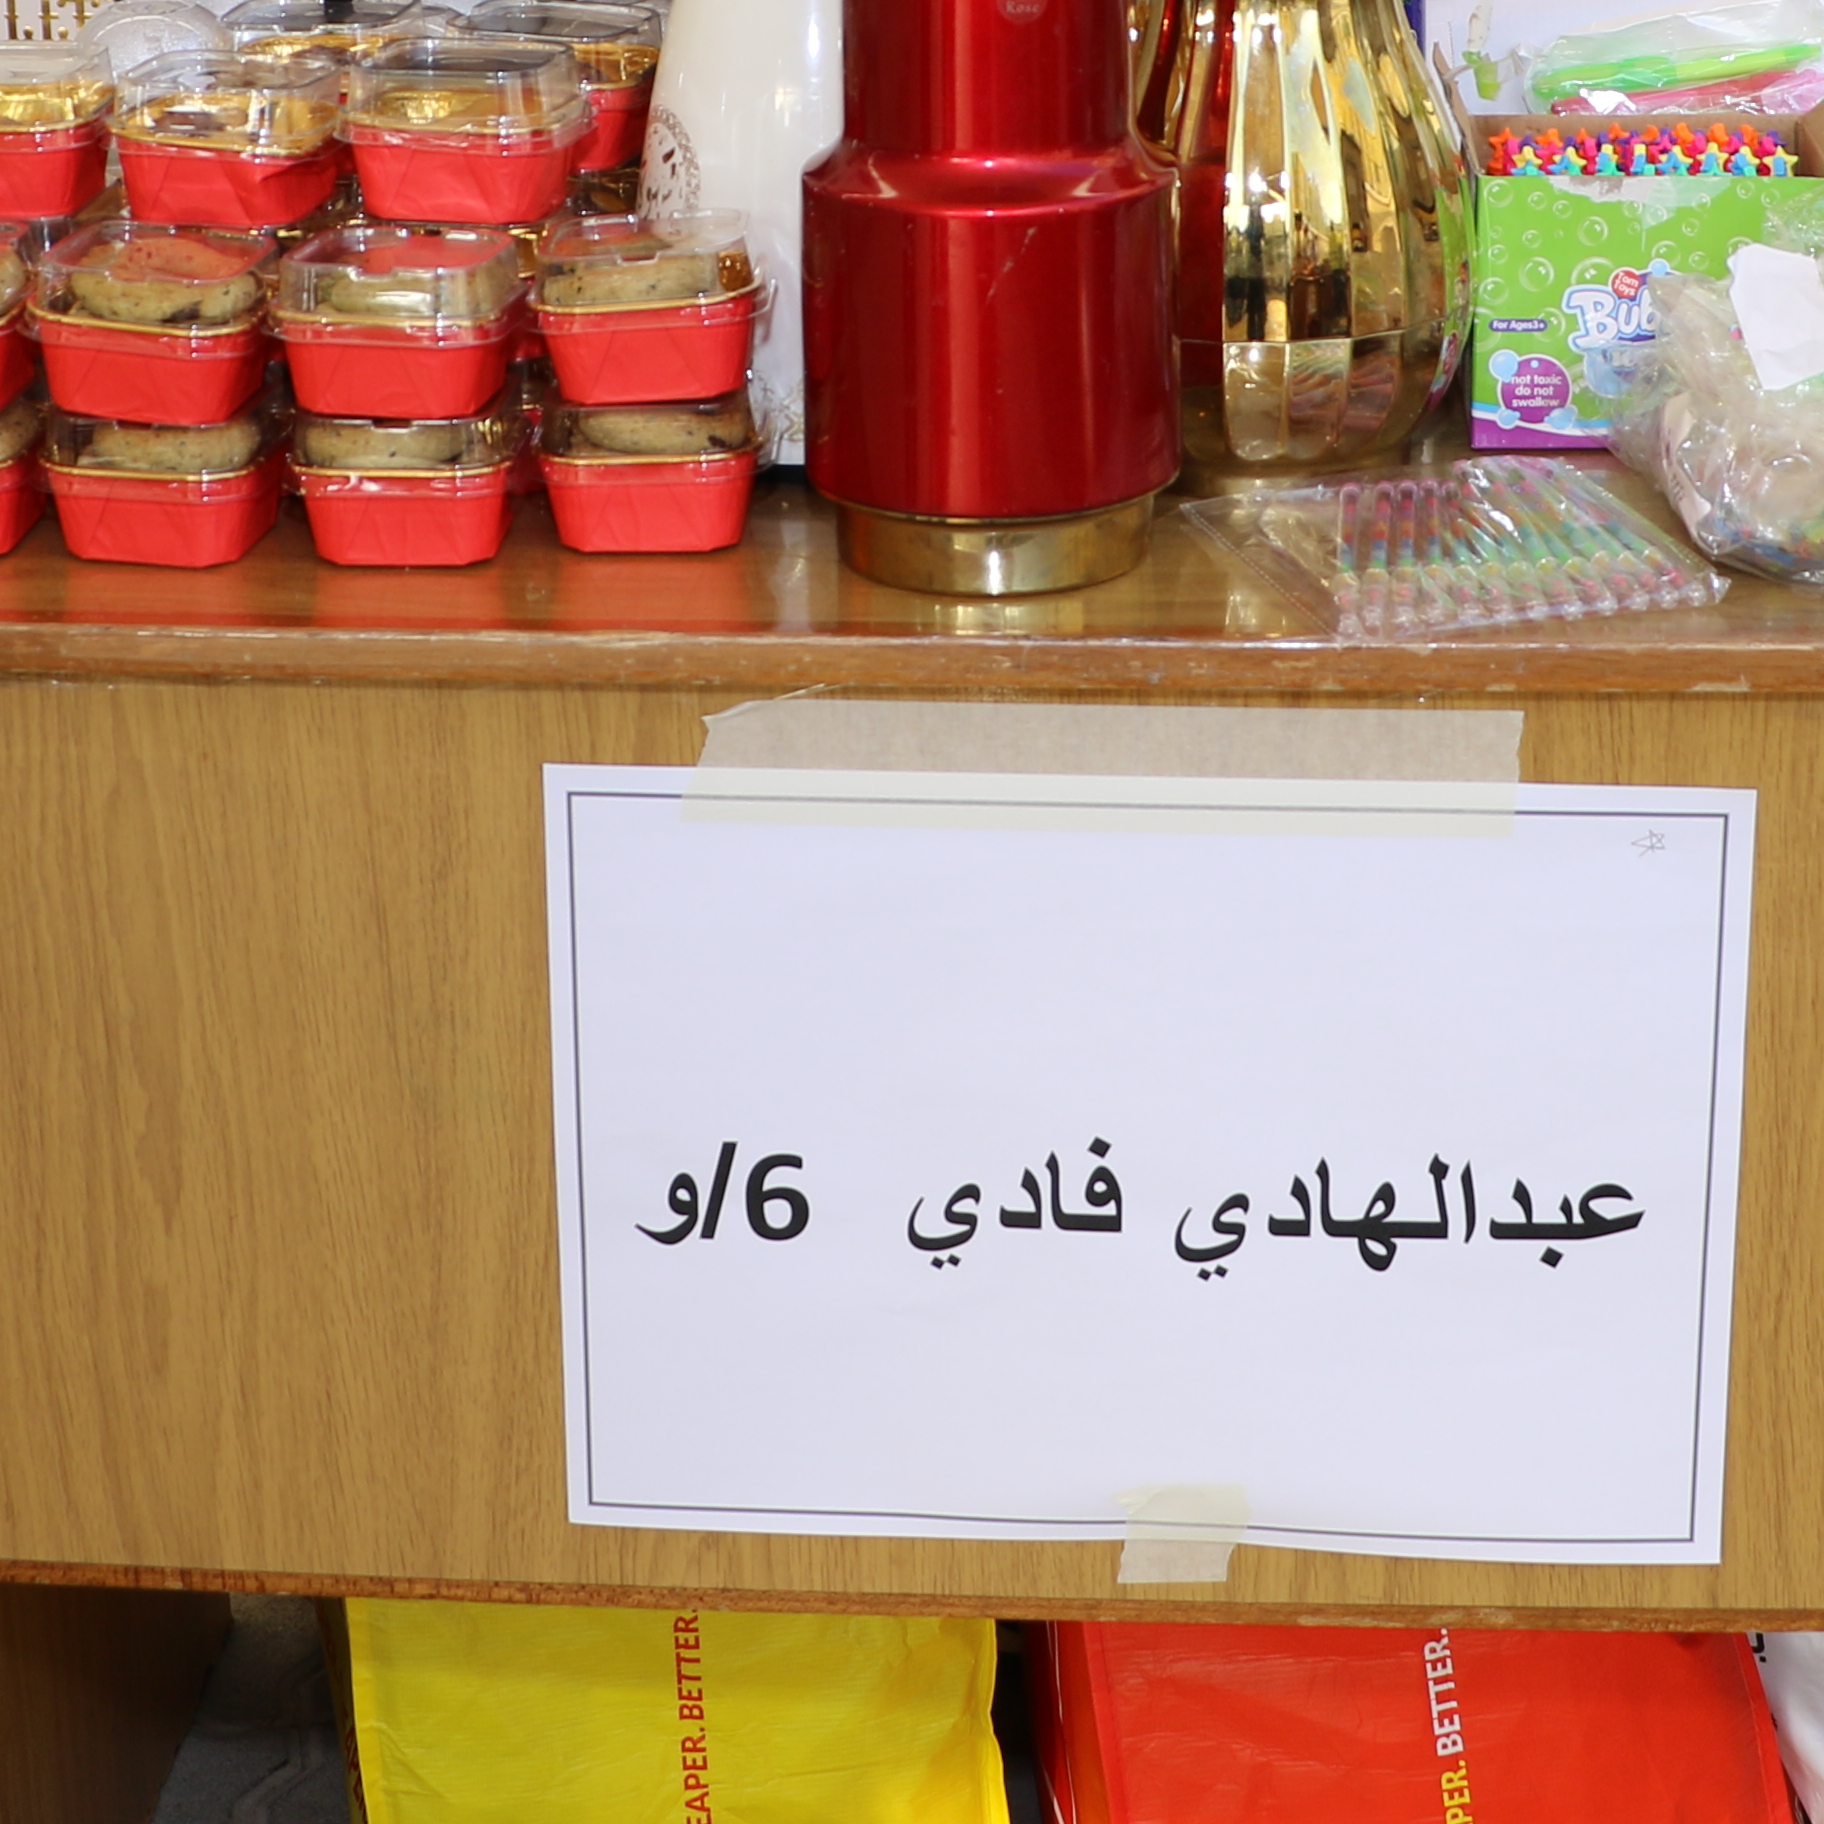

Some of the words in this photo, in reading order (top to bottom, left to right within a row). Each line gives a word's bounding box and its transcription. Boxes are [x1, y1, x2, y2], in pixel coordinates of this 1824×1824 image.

[1492, 320, 1509, 330] For
[1511, 375, 1532, 385] not
[1534, 374, 1563, 385] toxic
[1512, 396, 1560, 408] swallow
[1514, 385, 1532, 396] do
[1533, 386, 1555, 396] not
[906, 1136, 1123, 1270] فادي
[1174, 1153, 1645, 1281] عبدالهادي
[673, 1608, 705, 1720] BETTER.
[1423, 1628, 1465, 1757] BETTER.
